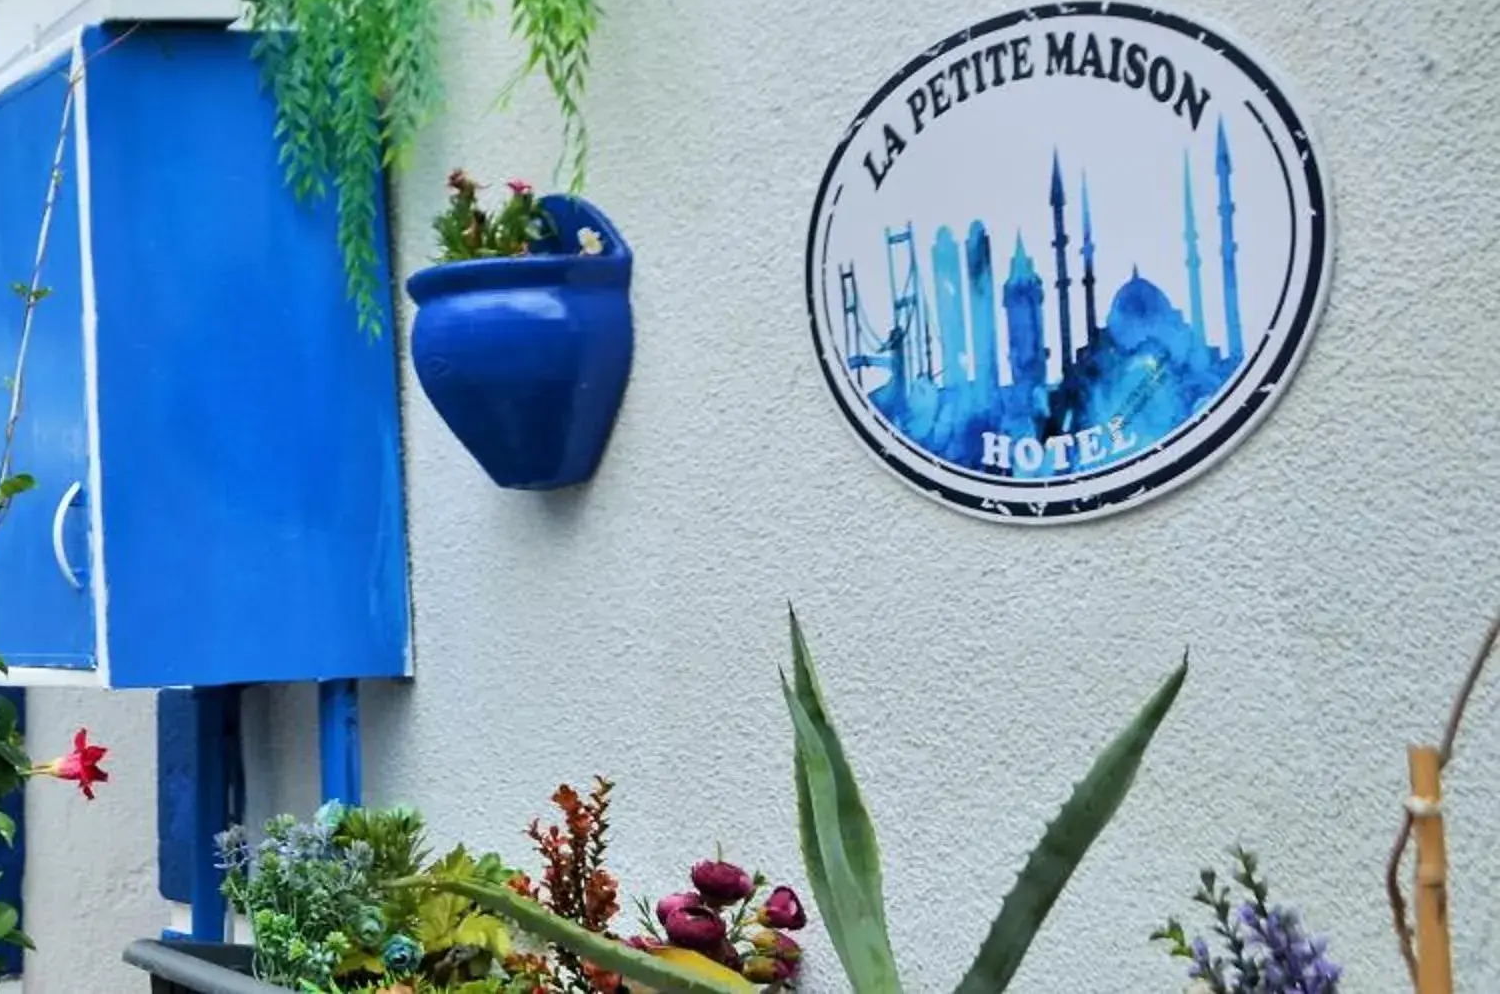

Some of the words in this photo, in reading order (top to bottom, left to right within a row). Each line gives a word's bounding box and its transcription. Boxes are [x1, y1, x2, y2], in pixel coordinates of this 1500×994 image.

[863, 123, 906, 191] LA
[906, 36, 1035, 135] PETITE
[1045, 31, 1212, 132] MAISON
[981, 416, 1136, 470] HOTEL
